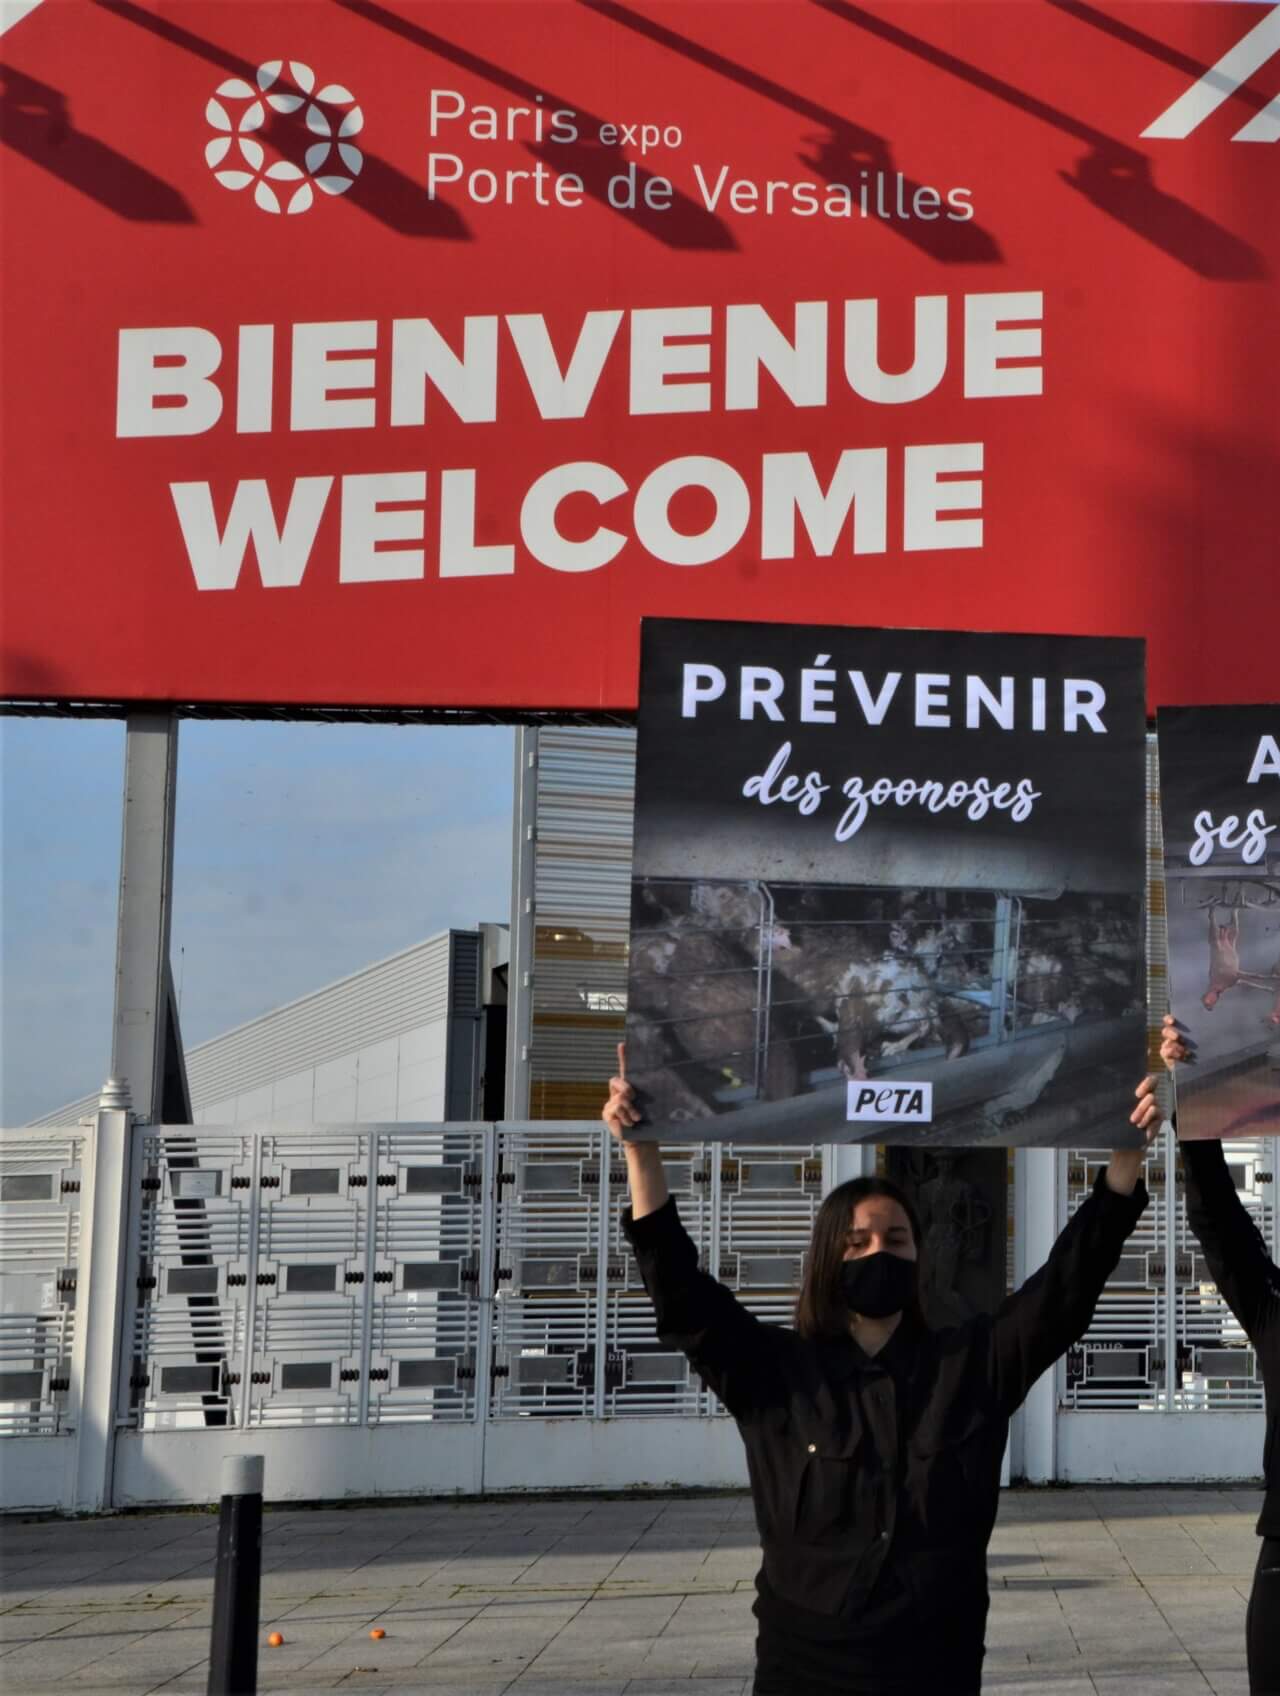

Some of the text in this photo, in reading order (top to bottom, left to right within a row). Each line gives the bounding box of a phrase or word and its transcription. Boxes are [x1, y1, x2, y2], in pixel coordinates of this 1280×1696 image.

[429, 88, 684, 155] Paris expo
[427, 152, 976, 222] Porte de Versailles
[116, 291, 1043, 438] BIENVENUE
[169, 442, 985, 592] WELCOME
[681, 653, 1108, 734] PRÉVENIR
[742, 741, 1042, 842] des zoonoses
[1188, 808, 1277, 867] ses
